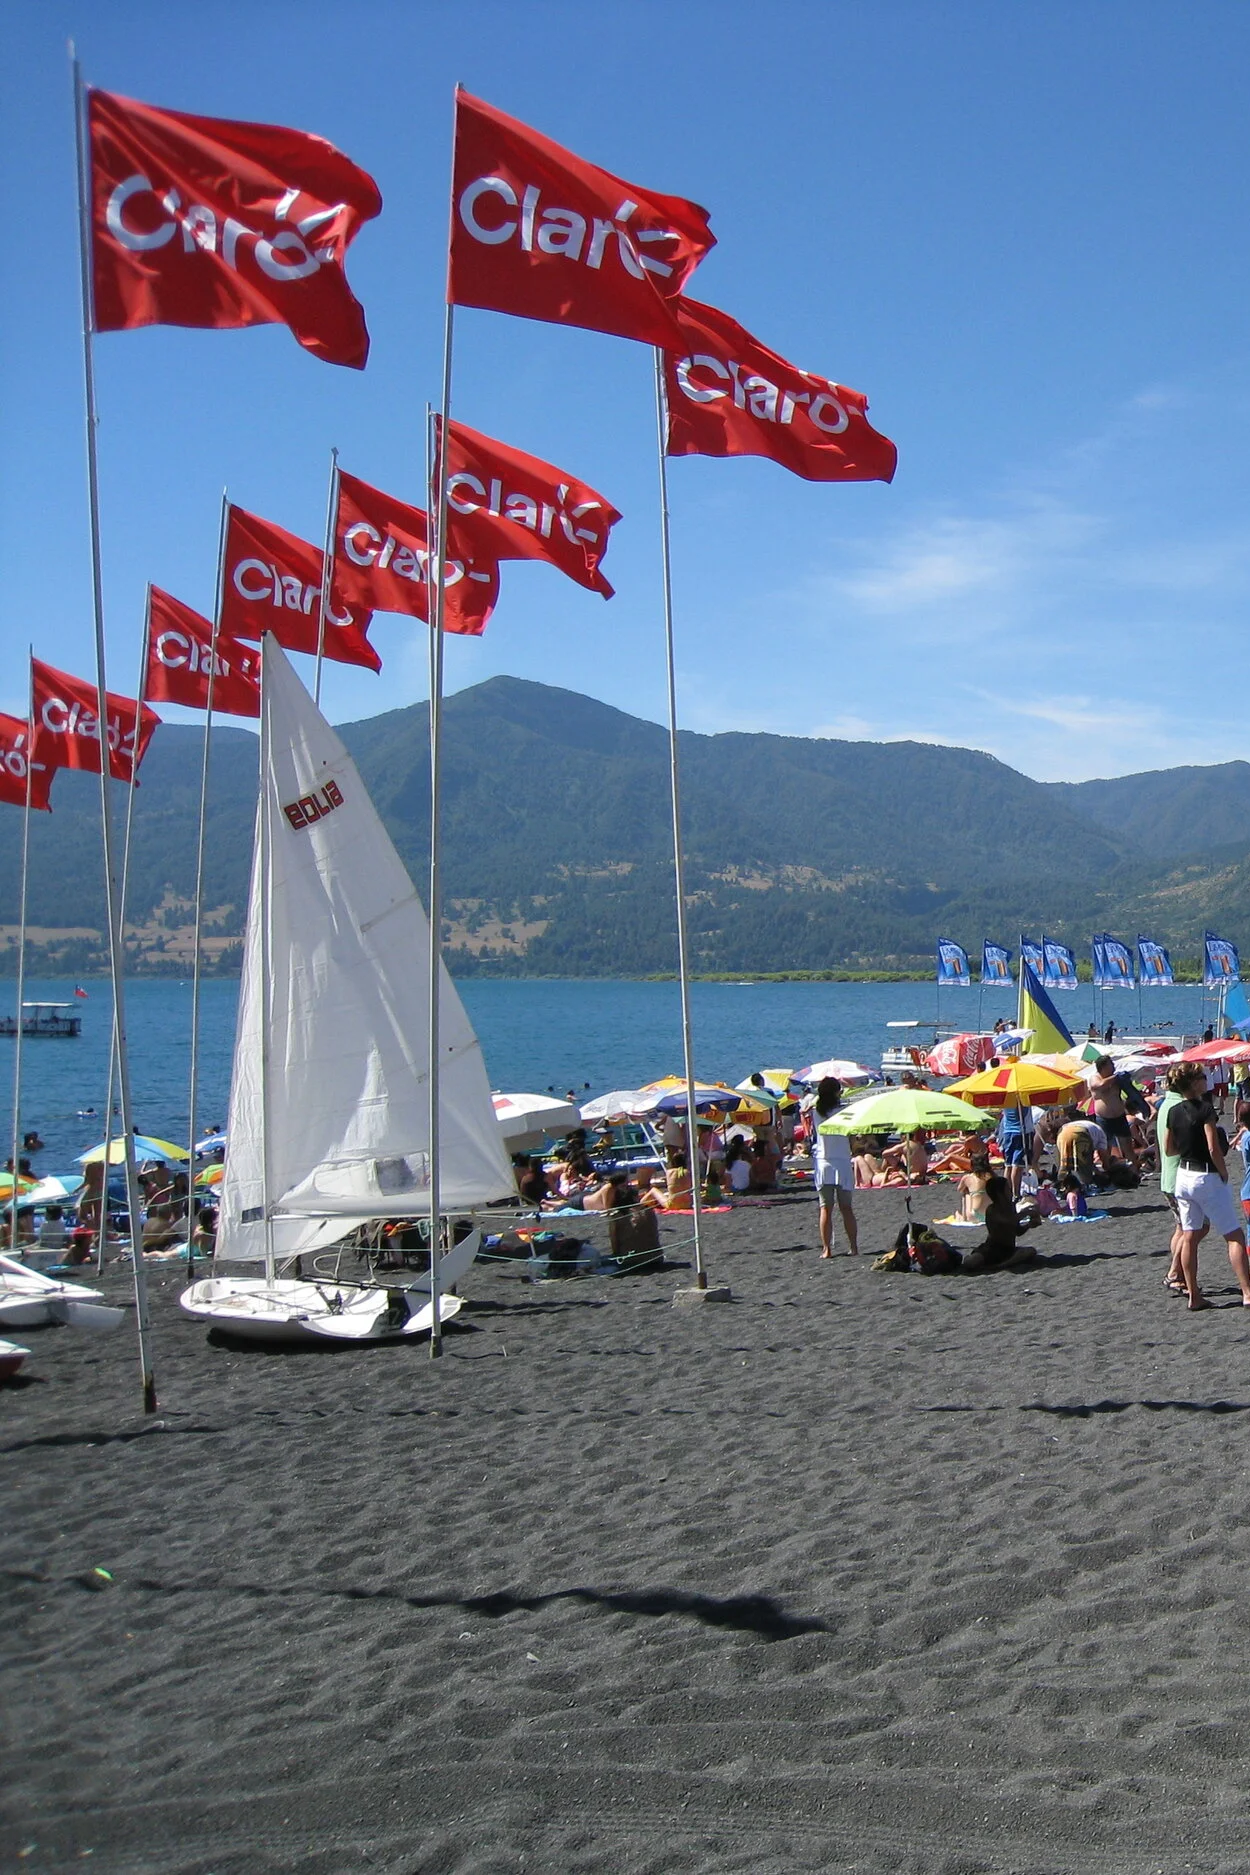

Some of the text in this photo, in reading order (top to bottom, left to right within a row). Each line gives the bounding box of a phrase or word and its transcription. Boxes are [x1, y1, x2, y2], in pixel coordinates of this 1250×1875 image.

[676, 354, 850, 434] Claro
[157, 631, 231, 677] Clar
[42, 698, 120, 750] Clao
